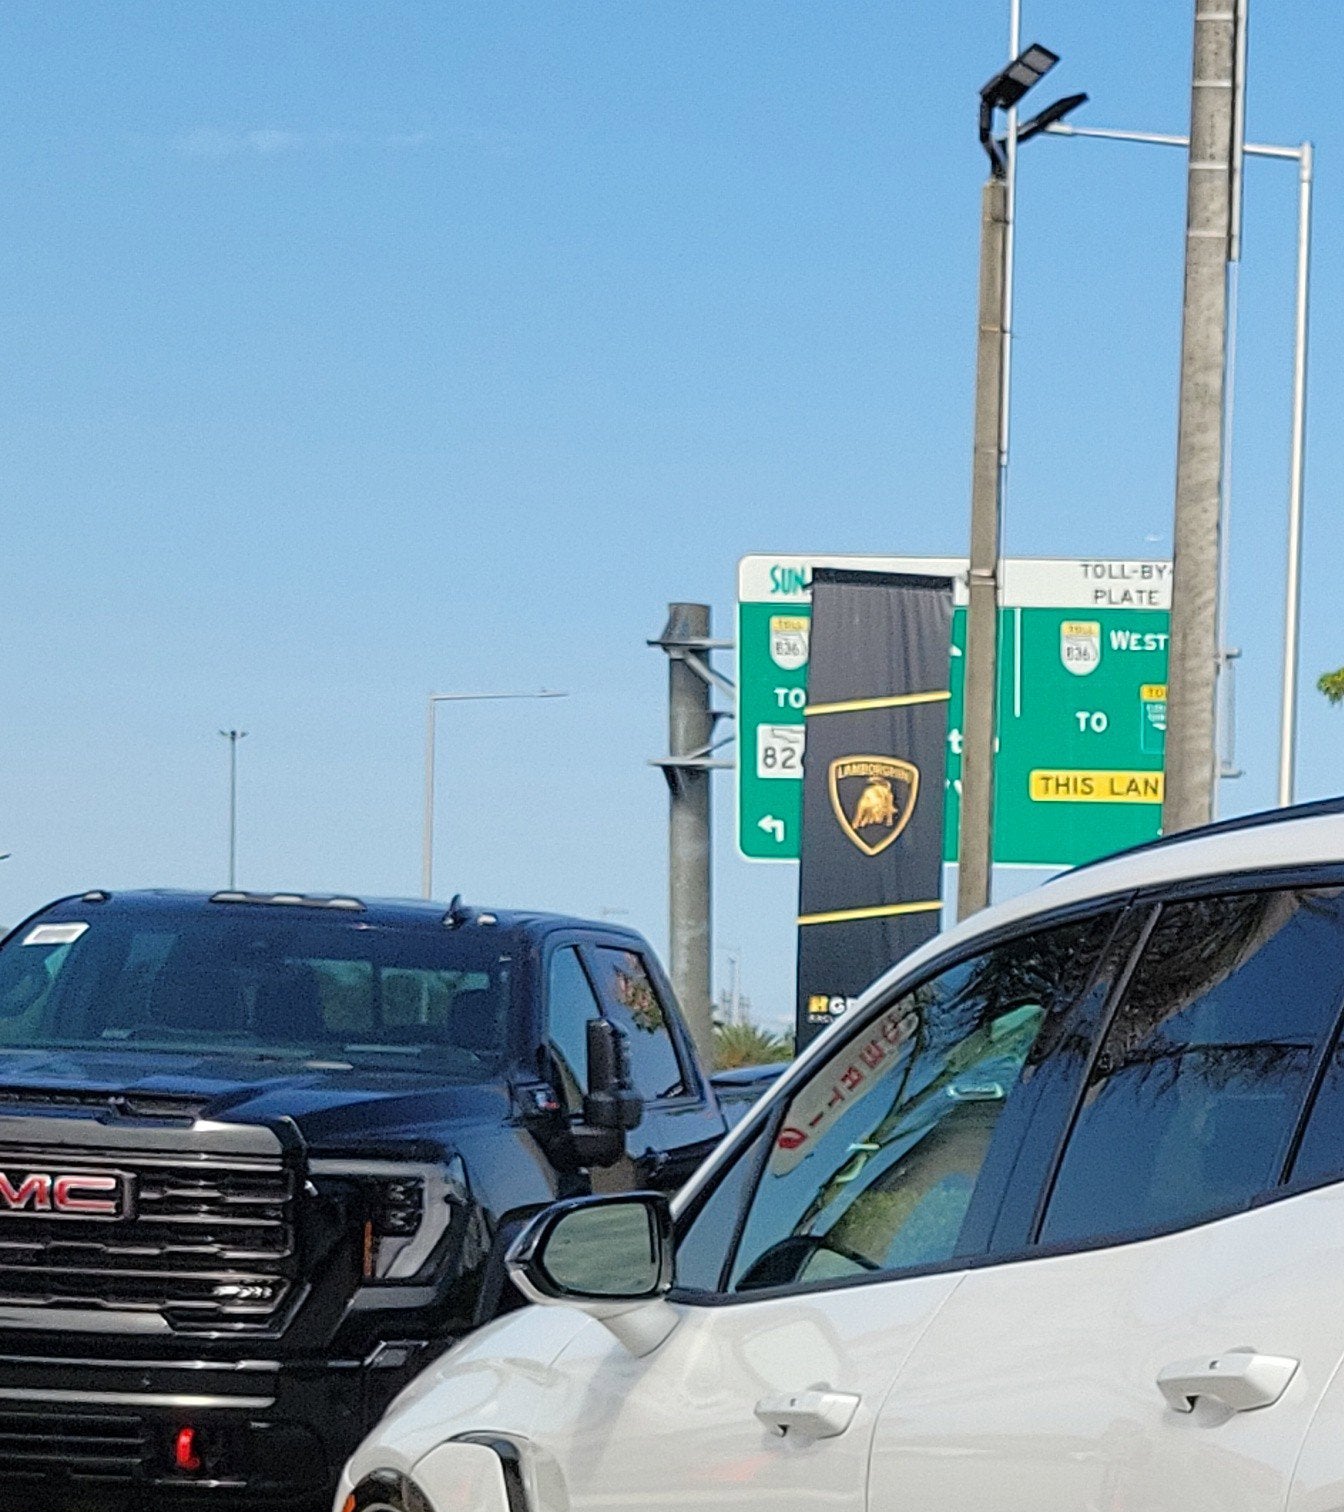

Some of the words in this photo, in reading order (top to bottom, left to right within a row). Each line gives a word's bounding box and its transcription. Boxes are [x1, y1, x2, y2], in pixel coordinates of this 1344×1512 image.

[769, 565, 807, 594] SUN
[1094, 589, 1160, 606] PLATE
[773, 687, 806, 708] TO
[1148, 687, 1164, 698] TO
[1075, 711, 1108, 733] TO
[763, 747, 804, 770] 82
[1040, 776, 1095, 796] THIS
[1109, 777, 1160, 797] LAN
[0, 1172, 117, 1213] MC
